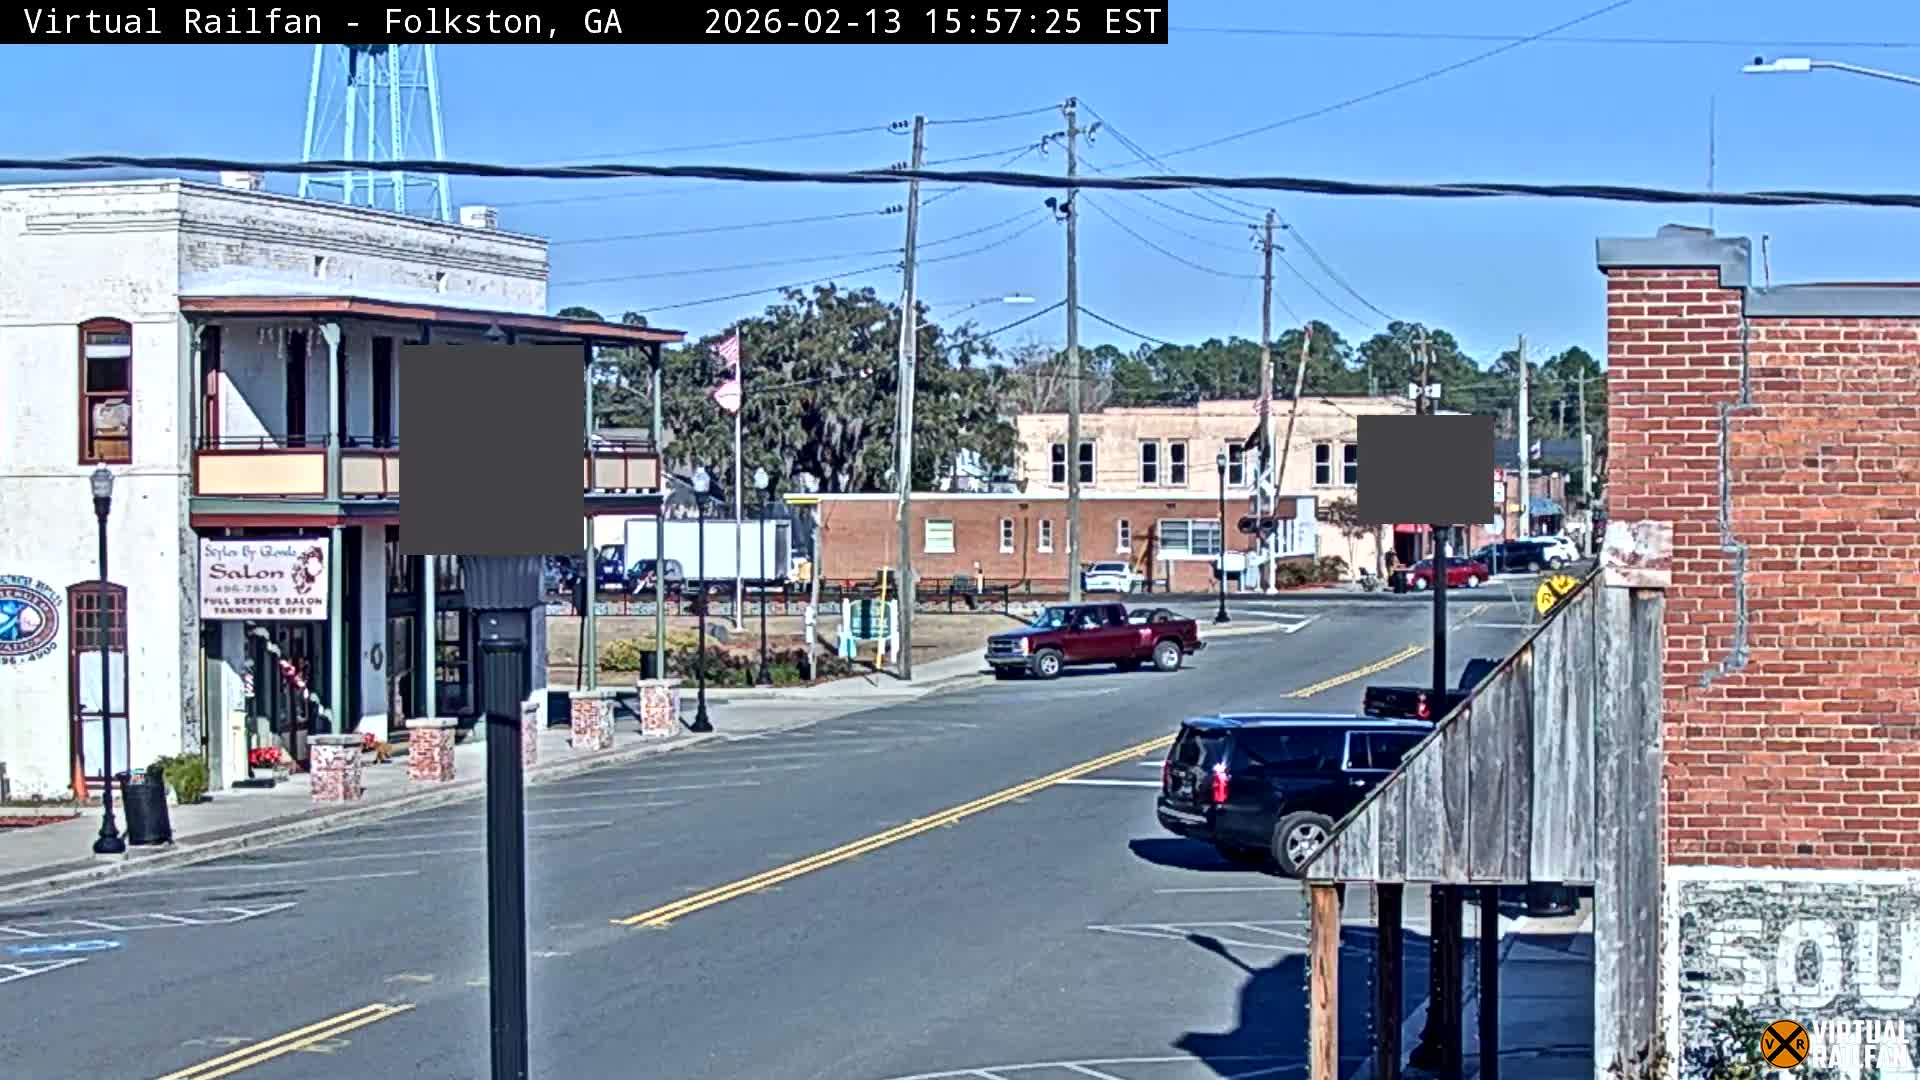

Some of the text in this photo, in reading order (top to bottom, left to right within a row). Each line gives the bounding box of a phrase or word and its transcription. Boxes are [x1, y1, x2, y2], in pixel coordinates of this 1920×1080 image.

[209, 563, 284, 579] Salon
[234, 598, 280, 606] SERVICE
[285, 598, 323, 606] SALON
[214, 607, 312, 615] TANNING & GIFTS
